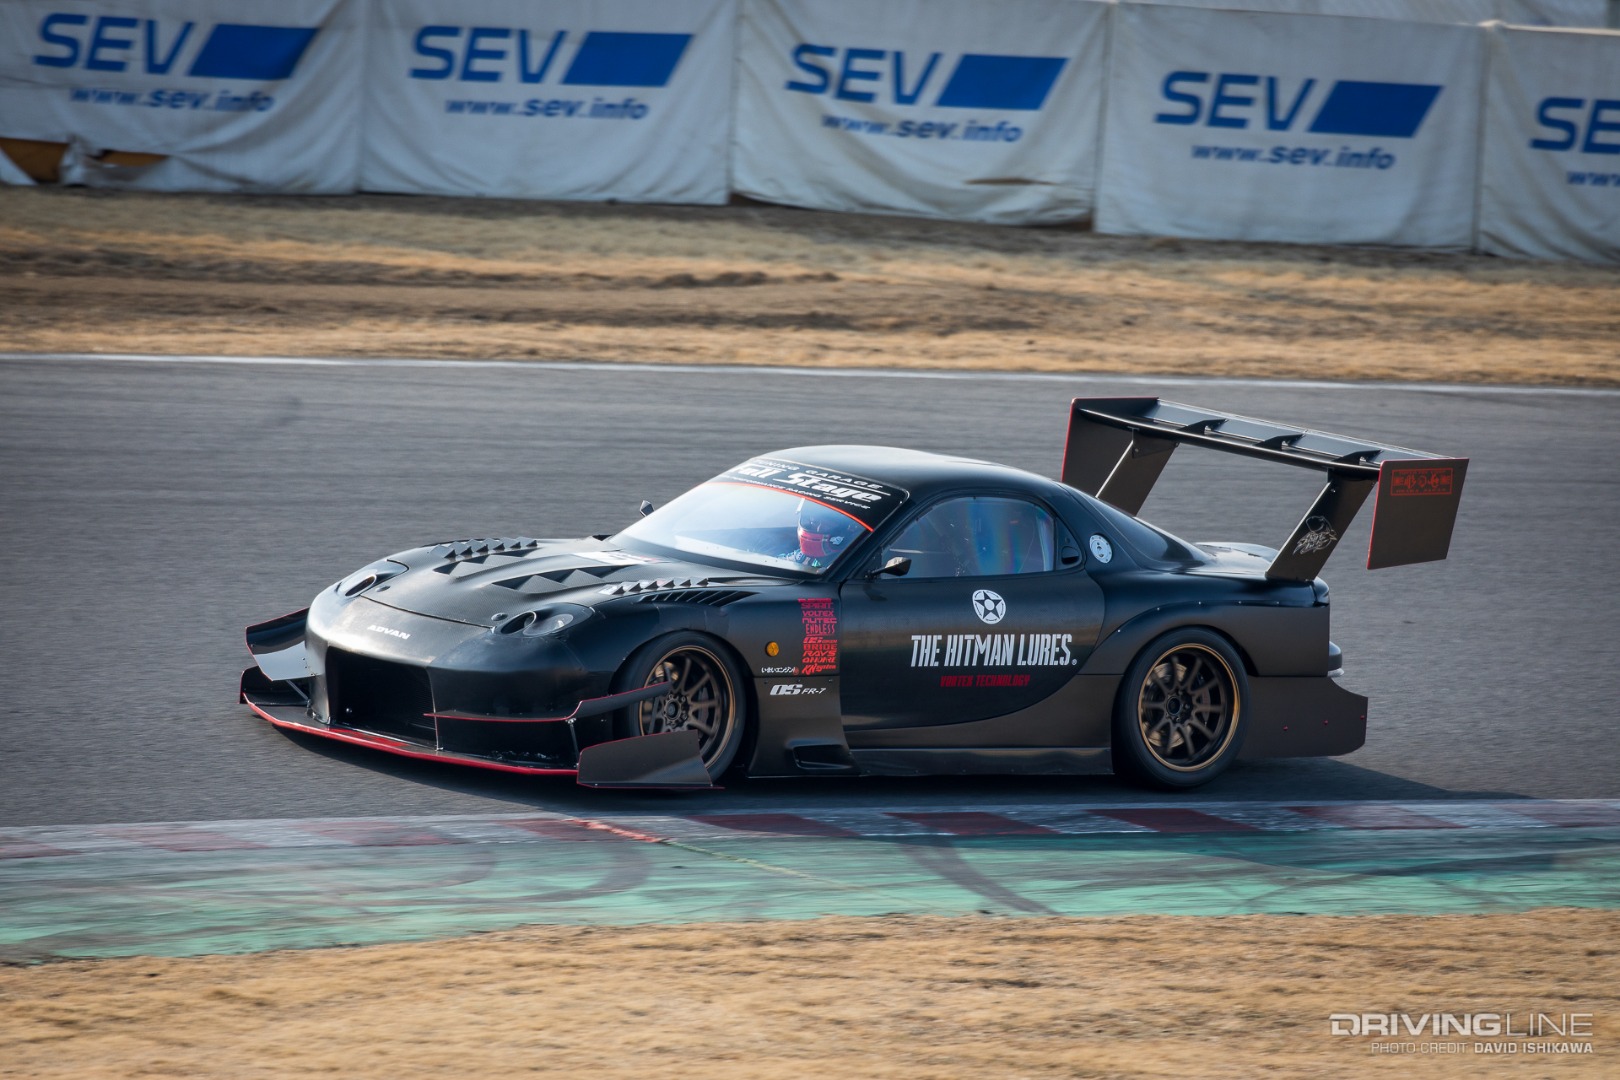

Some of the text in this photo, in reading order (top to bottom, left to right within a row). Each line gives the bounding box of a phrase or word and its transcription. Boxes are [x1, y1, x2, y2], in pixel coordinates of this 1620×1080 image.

[33, 14, 195, 74] SEV
[410, 25, 569, 84] SEV
[785, 43, 943, 106] SEV
[70, 86, 276, 113] www.sev.info
[445, 96, 650, 121] www.sev.info
[1154, 70, 1319, 131] SEV
[822, 113, 1022, 143] www.sev.info
[1191, 143, 1396, 171] www.sev.info
[367, 624, 411, 640] ADVAN
[806, 624, 835, 635] ENDLESS
[911, 635, 942, 667] THE
[944, 634, 1015, 666] HITMAN
